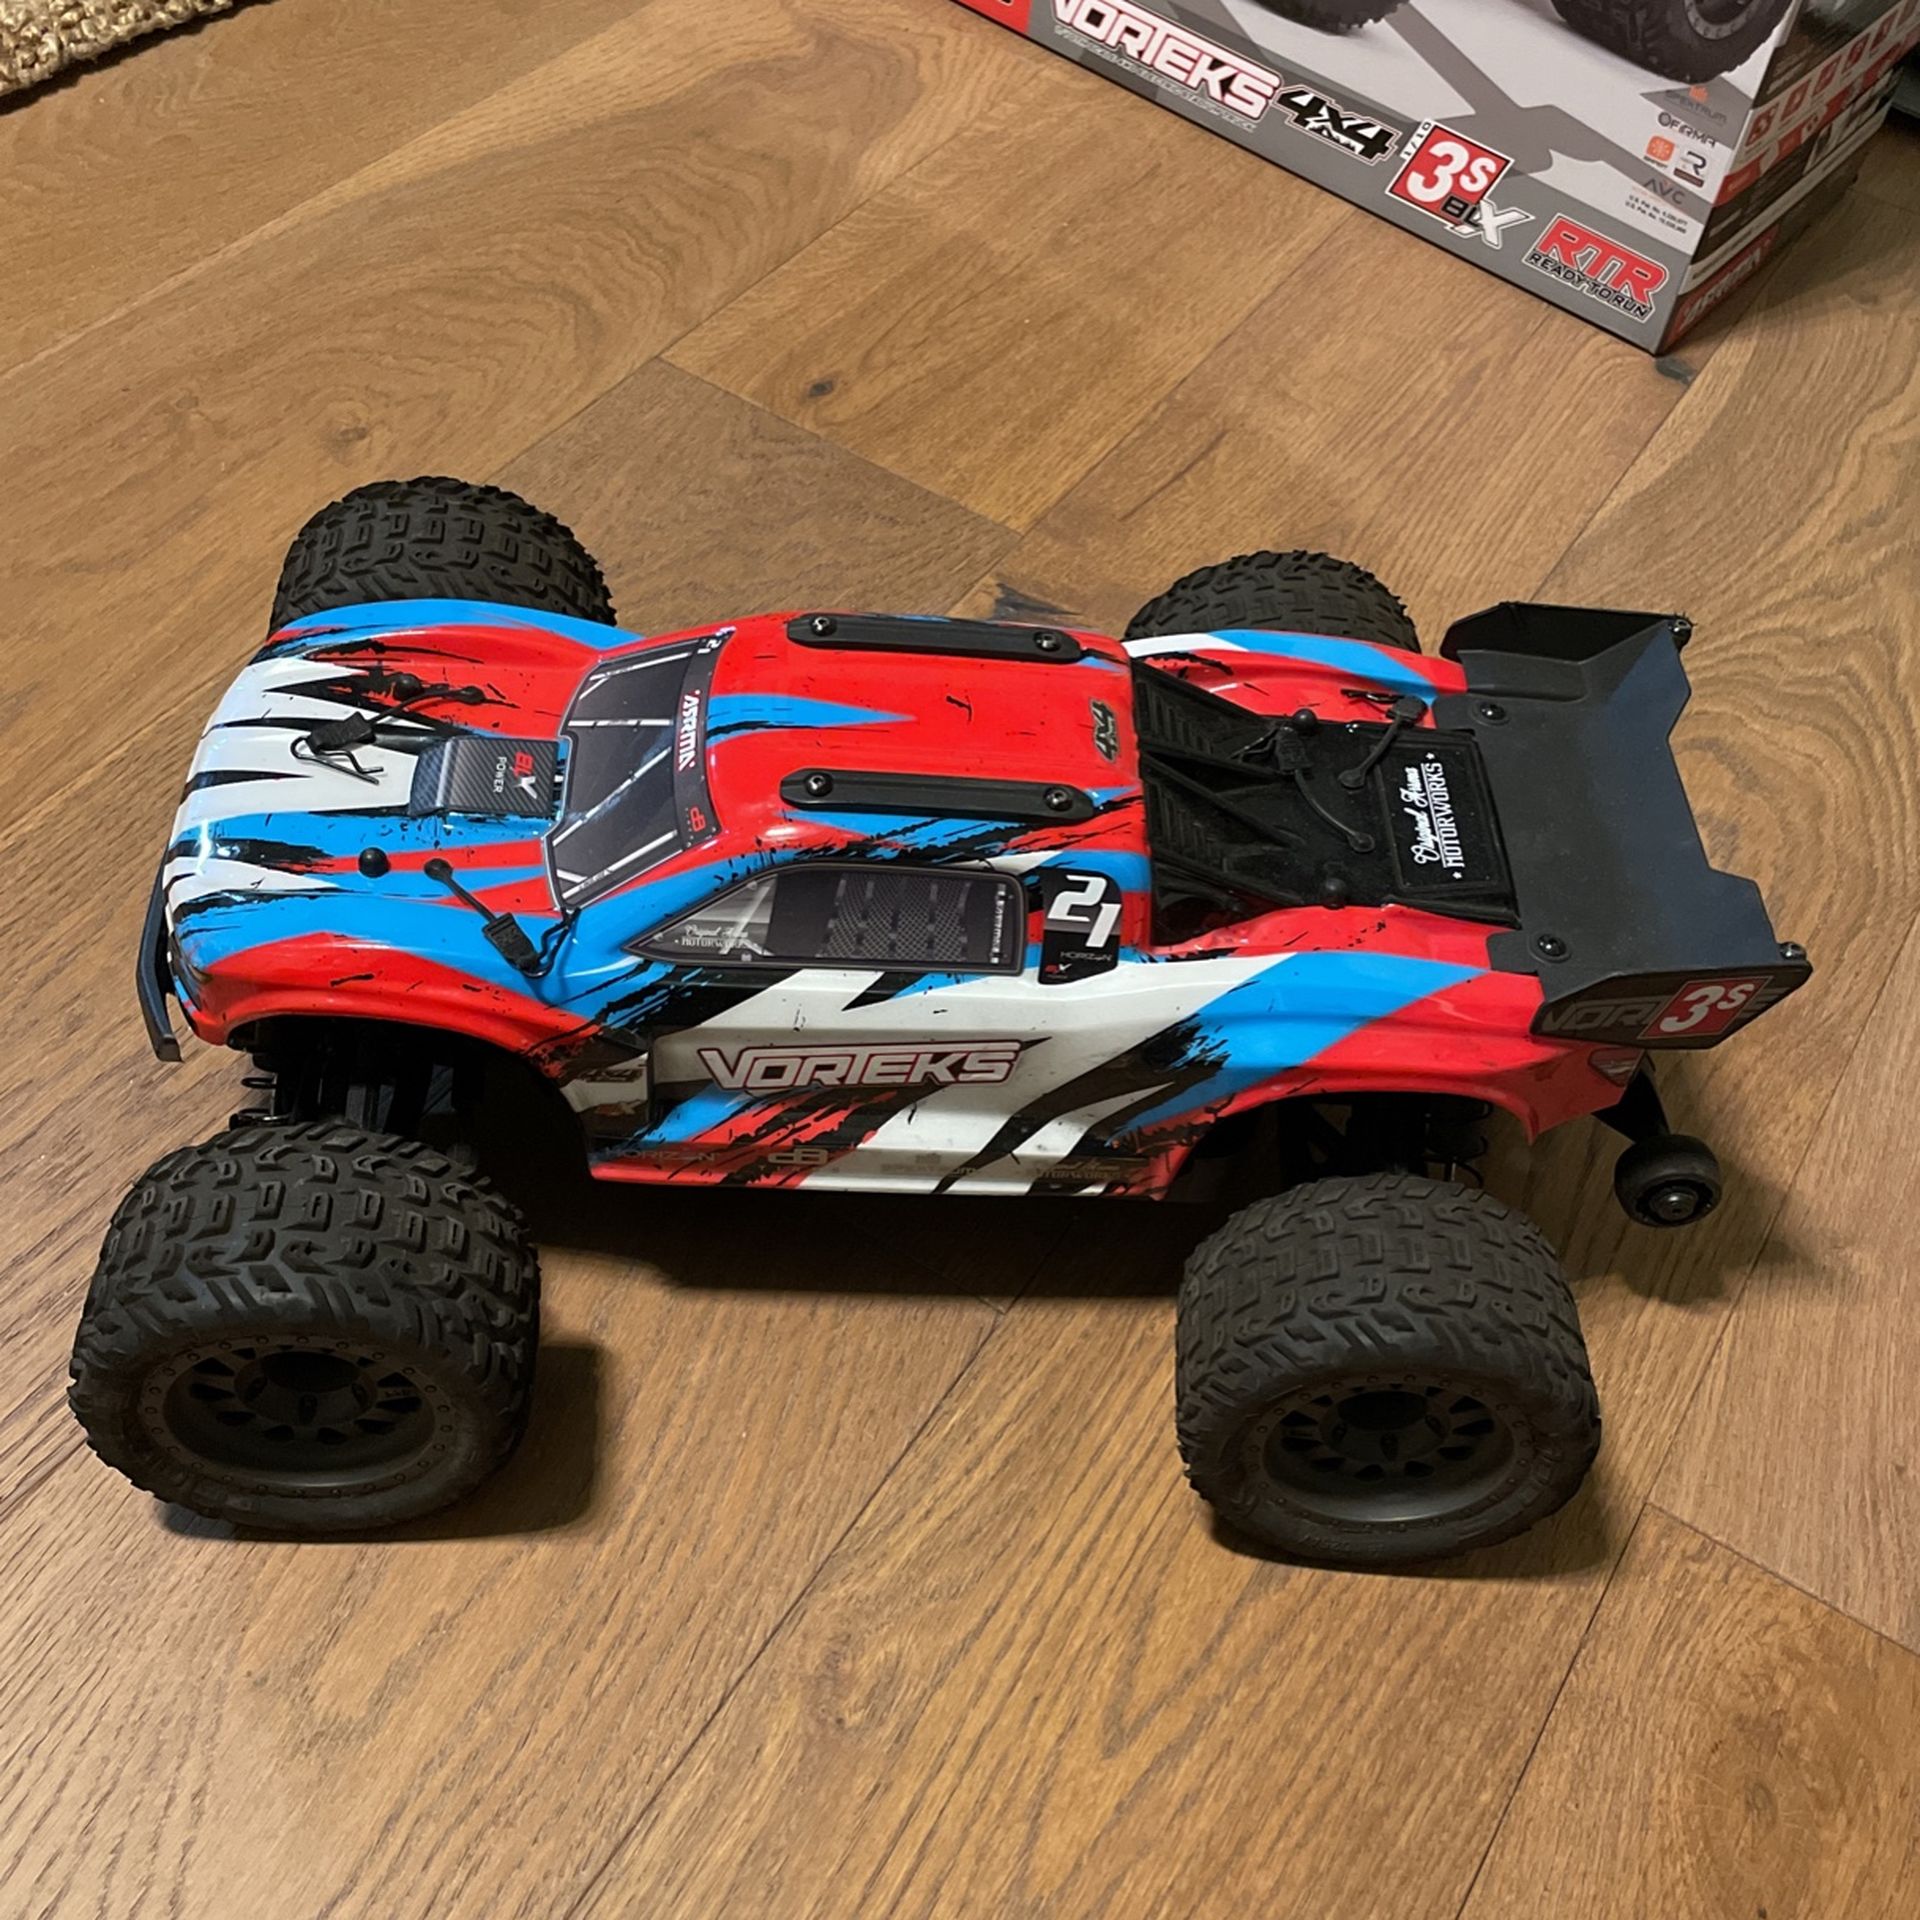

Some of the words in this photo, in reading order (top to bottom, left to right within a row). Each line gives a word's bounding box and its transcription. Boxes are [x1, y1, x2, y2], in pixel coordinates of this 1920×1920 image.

[1054, 0, 1282, 120] VORTEKS
[1404, 122, 1432, 156] 1/10
[1406, 140, 1497, 203] 3S
[1536, 217, 1666, 306] RTR
[1425, 763, 1466, 868] MOTORWORKS
[1047, 874, 1122, 948] 21
[1660, 983, 1754, 1032] 3S
[699, 1040, 1023, 1089] VORTEKS
